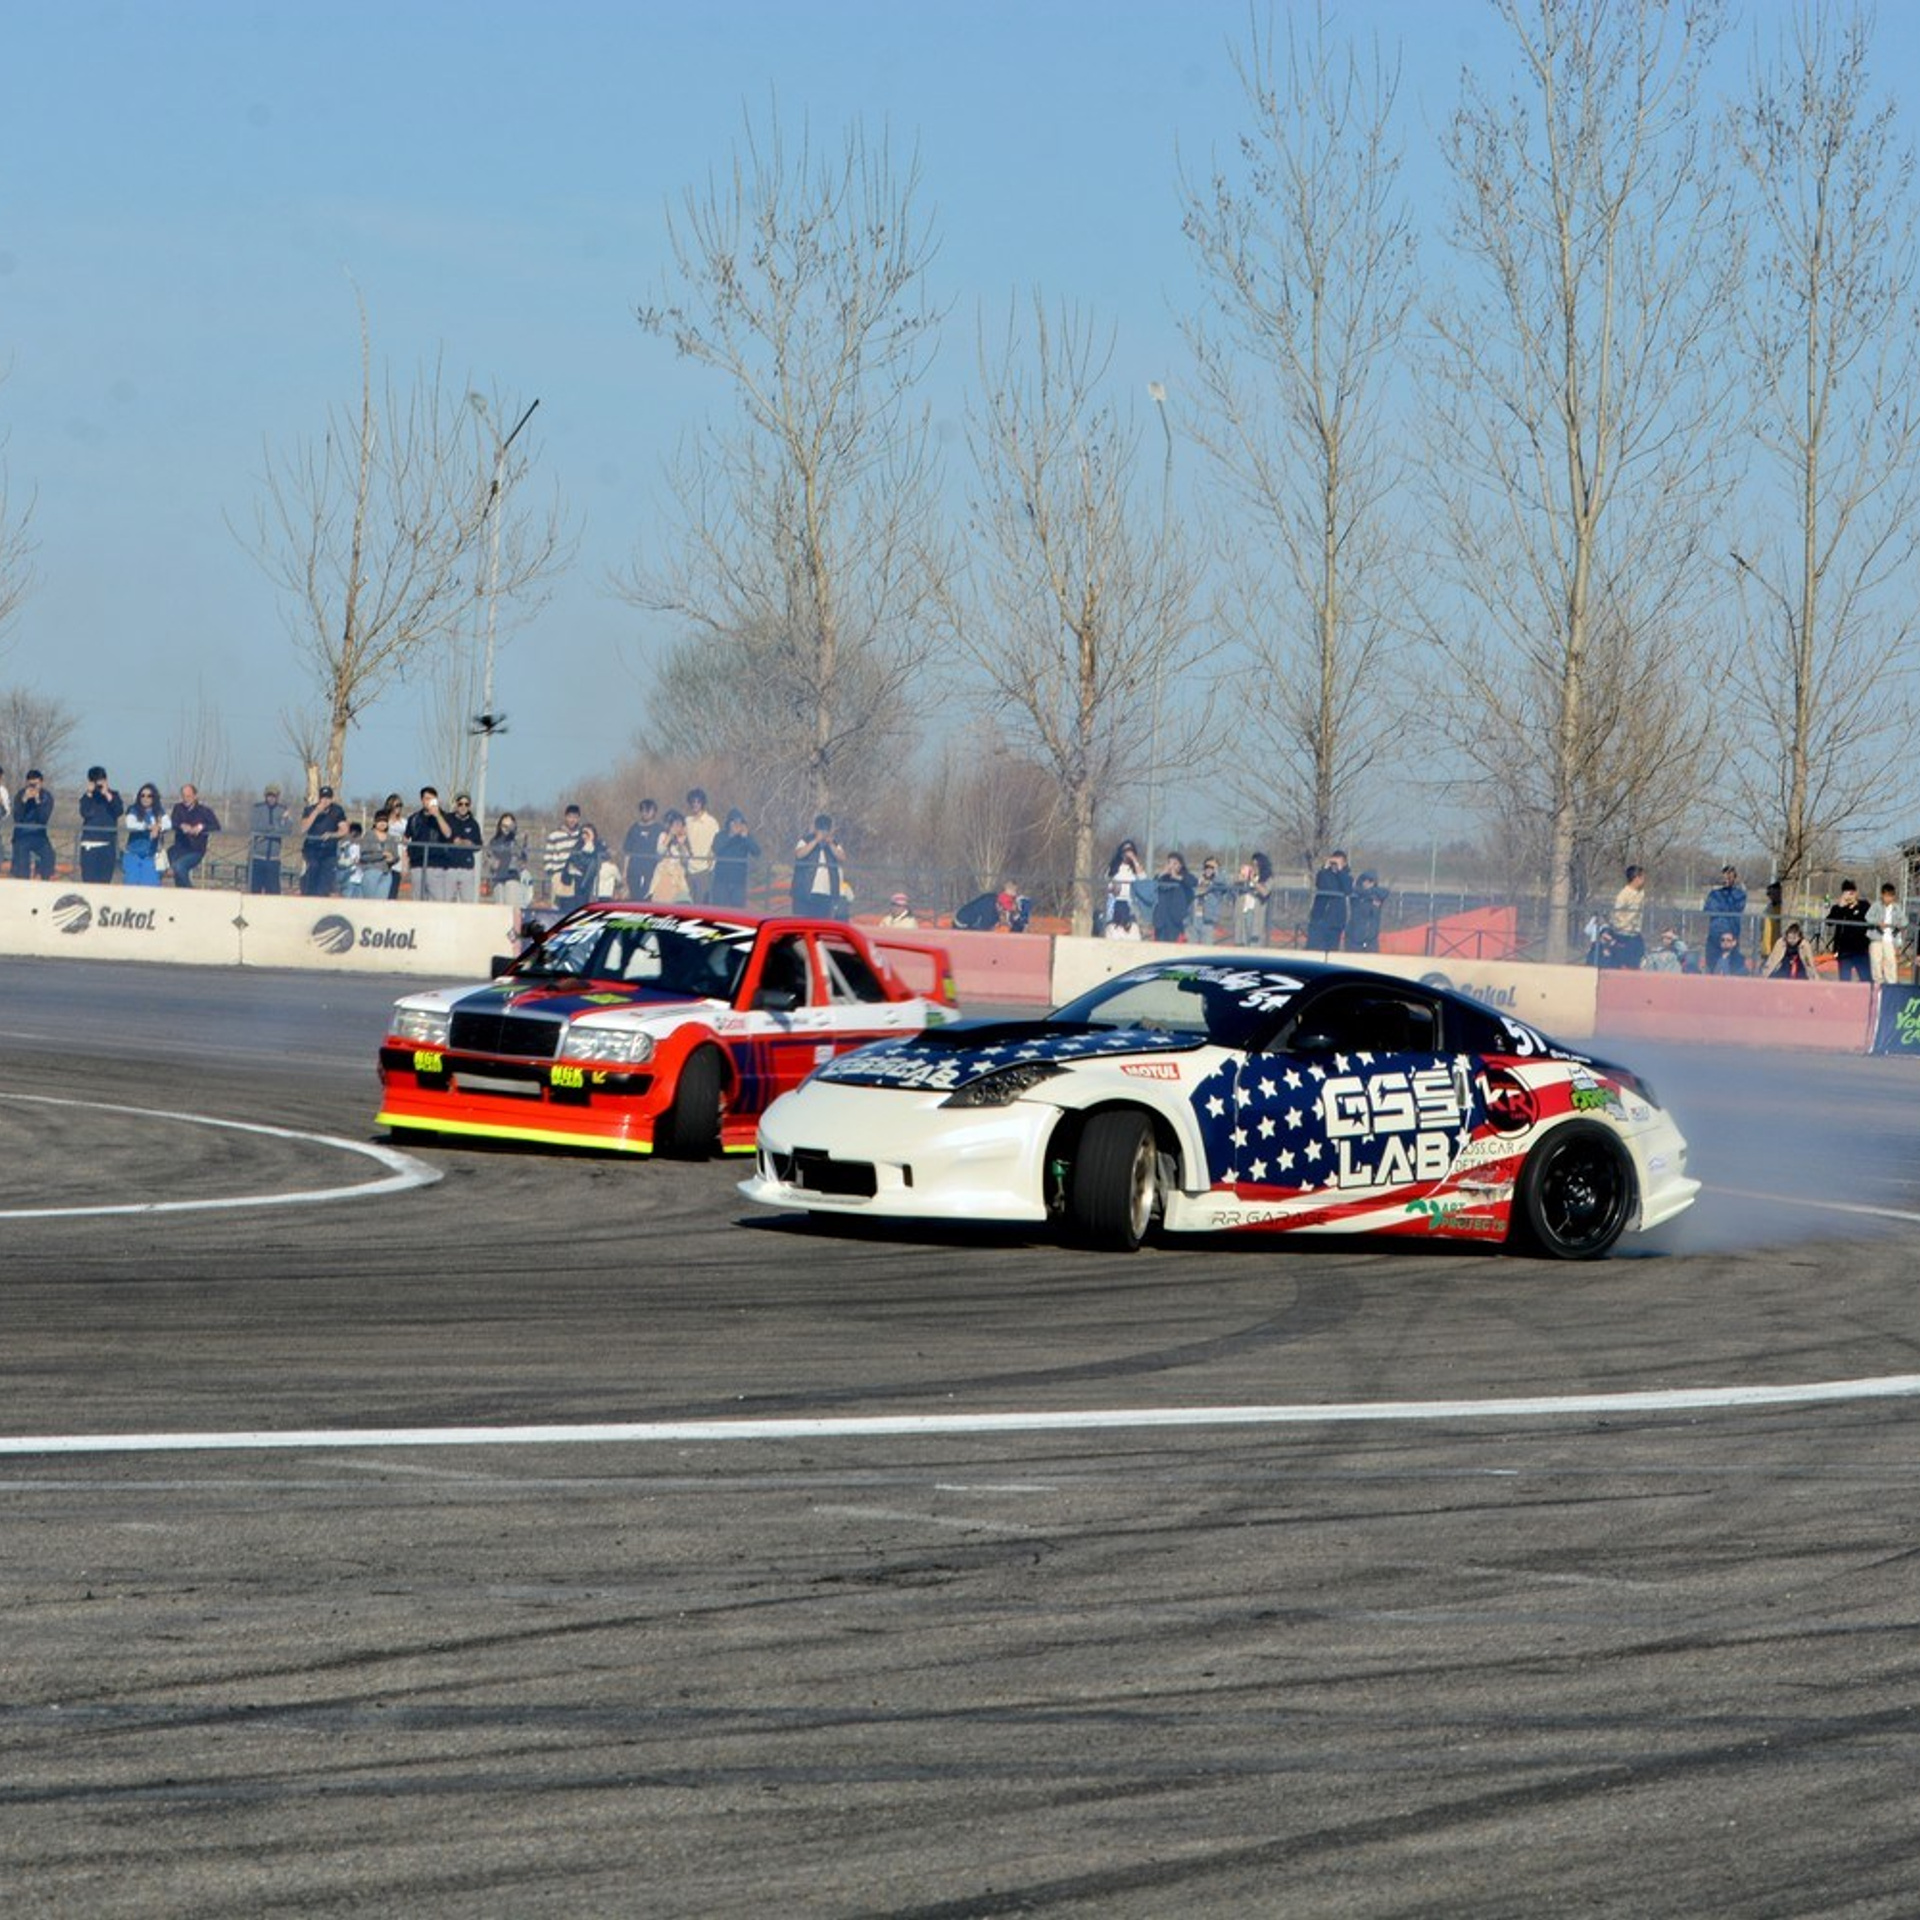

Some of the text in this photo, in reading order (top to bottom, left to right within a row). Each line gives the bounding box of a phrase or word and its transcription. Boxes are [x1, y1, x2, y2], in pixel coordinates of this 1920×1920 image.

[98, 905, 156, 931] Sokol
[359, 927, 418, 951] Sokol
[1123, 1064, 1177, 1080] MOTUL
[1339, 1131, 1450, 1189] LAB
[1211, 1211, 1327, 1226] RR GARAGE
